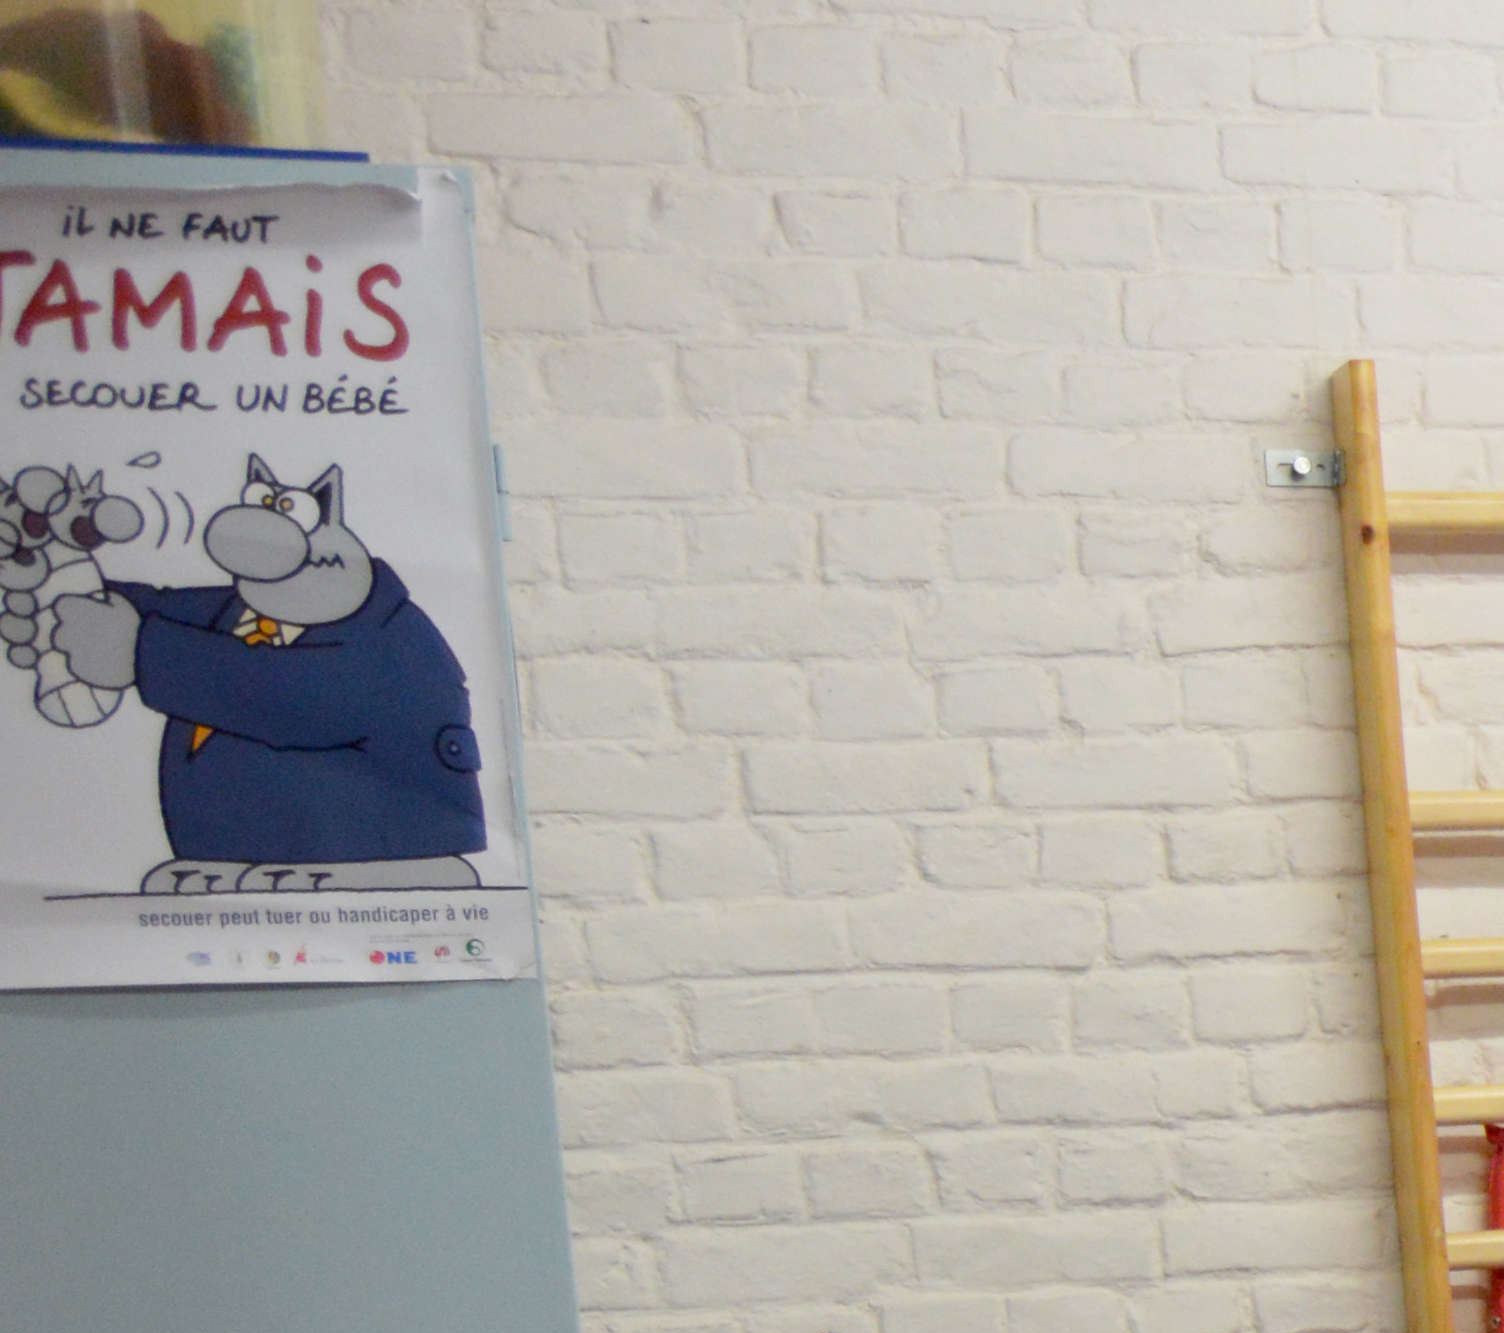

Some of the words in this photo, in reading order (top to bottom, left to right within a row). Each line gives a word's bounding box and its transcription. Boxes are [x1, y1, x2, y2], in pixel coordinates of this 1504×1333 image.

[109, 212, 164, 239] NE
[182, 212, 280, 245] FAUT
[19, 377, 219, 411] SECOUER
[236, 382, 289, 413] UN
[302, 373, 410, 416] BÉBÉ
[139, 908, 212, 928] secouer
[219, 908, 260, 930] peut
[266, 908, 303, 926] tuer
[310, 909, 331, 926] ou
[338, 905, 439, 927] handicaper
[445, 904, 456, 922] à
[463, 904, 489, 922] vie
